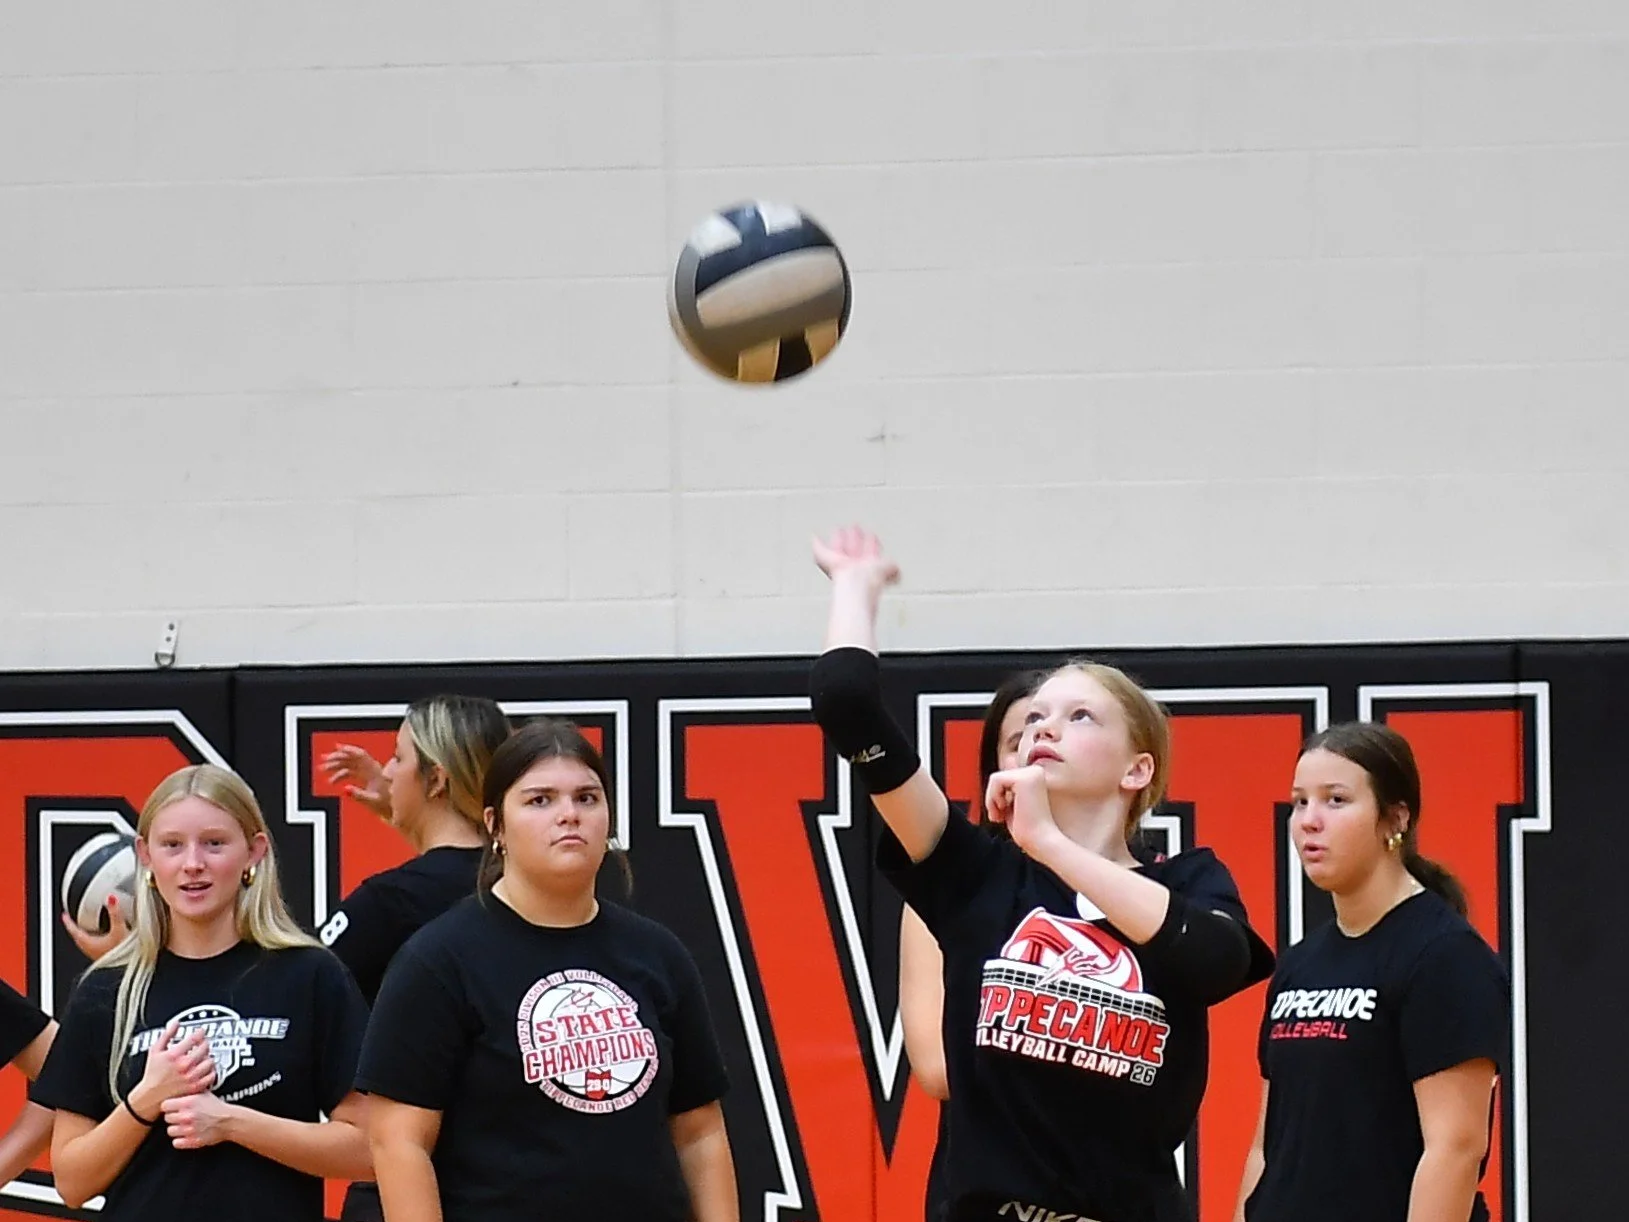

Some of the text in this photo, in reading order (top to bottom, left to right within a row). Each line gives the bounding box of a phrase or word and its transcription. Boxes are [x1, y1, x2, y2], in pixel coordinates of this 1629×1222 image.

[320, 910, 349, 946] 8
[535, 1005, 638, 1044] STATE
[1270, 1021, 1348, 1039] OLLEYBALL
[525, 1030, 656, 1081] CHAMPIONS
[976, 1027, 1156, 1085] LLEYBALL CAMP 26
